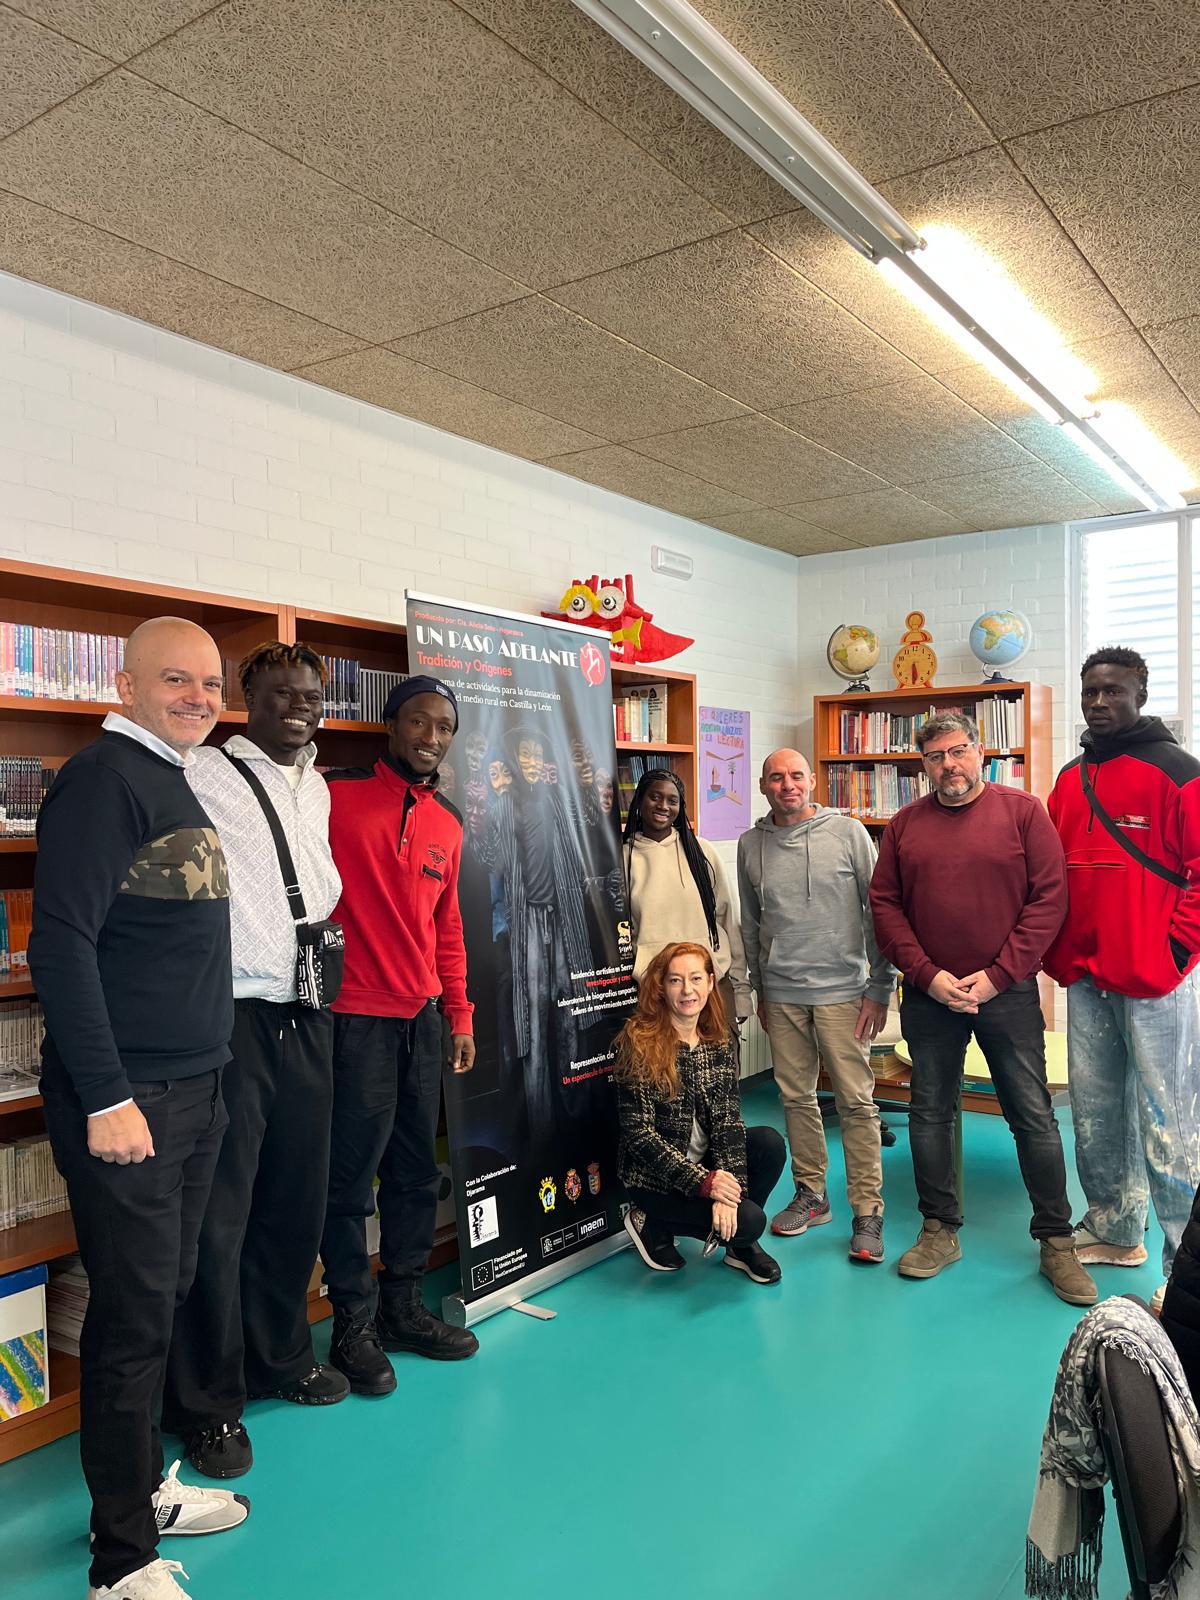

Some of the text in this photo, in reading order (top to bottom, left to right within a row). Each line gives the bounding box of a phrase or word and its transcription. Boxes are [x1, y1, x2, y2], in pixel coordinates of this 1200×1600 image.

[416, 625, 579, 668] UN PASO ADELANTE
[416, 651, 463, 670] Tradición
[465, 661, 472, 673] y
[456, 679, 465, 688] de
[466, 682, 501, 694] actividades
[501, 687, 517, 695] para
[517, 686, 524, 695] la
[463, 694, 484, 704] medio
[484, 696, 498, 706] rural
[499, 699, 508, 708] en
[508, 700, 533, 710] Castilla
[533, 703, 538, 712] y
[586, 993, 591, 1001] de
[587, 1004, 594, 1012] de
[606, 1050, 615, 1059] de
[562, 1076, 571, 1085] Un
[465, 1179, 476, 1187] Con
[481, 1166, 510, 1182] Colaboración
[493, 1247, 523, 1264] Financiado por
